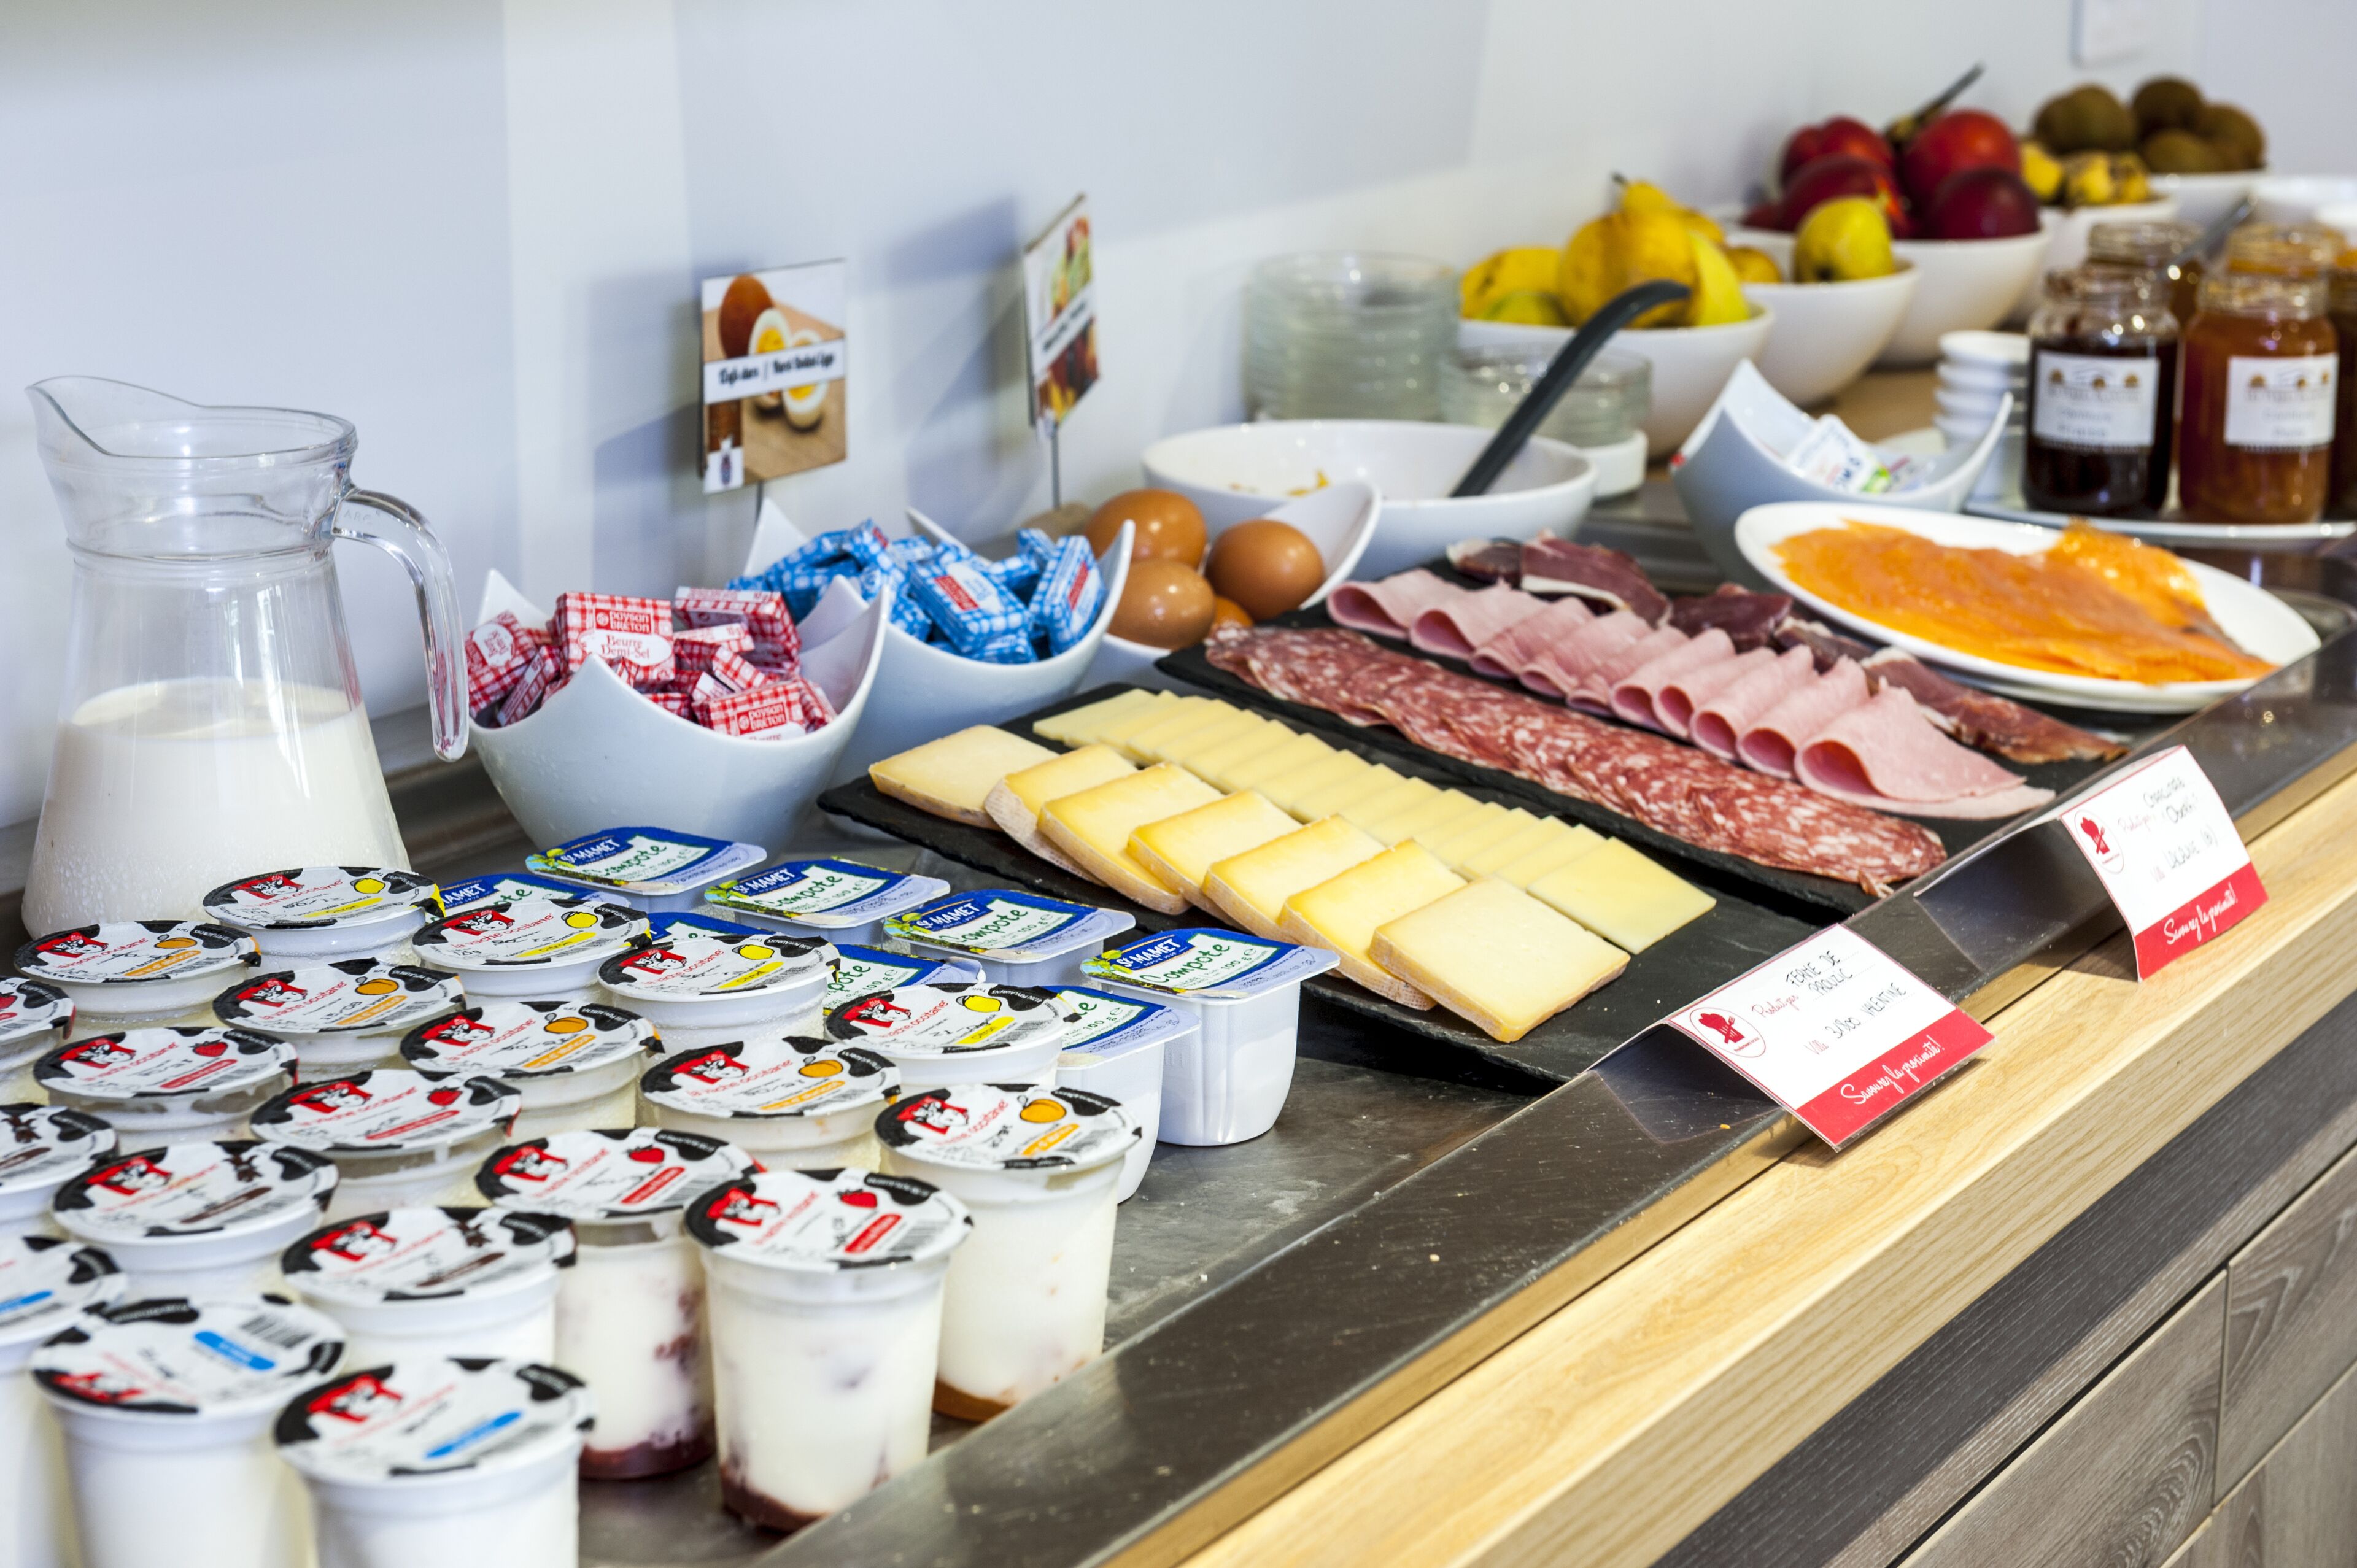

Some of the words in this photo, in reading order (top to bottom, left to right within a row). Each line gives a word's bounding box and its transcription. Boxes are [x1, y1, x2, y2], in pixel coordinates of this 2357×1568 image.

[610, 611, 649, 624] paysan
[601, 644, 650, 659] Demi-Sel
[606, 635, 643, 649] Beurre
[748, 703, 783, 718] paysan
[576, 837, 620, 860] MAMET
[582, 843, 667, 876] Compote
[733, 885, 749, 894] St
[745, 867, 795, 890] MAMET
[754, 875, 843, 907] Compote
[916, 919, 934, 929] St
[929, 902, 980, 925] MAMET
[937, 908, 1029, 943] Compote
[464, 932, 503, 946] vache
[503, 913, 554, 935] occitane
[2164, 917, 2202, 945] Savourez
[99, 937, 149, 957] occitane
[538, 941, 575, 952] Citron
[1117, 957, 1134, 968] St
[1128, 938, 1182, 964] MAMET
[683, 948, 726, 973] occitane
[1139, 944, 1231, 984] Compote
[1220, 960, 1242, 970] 100
[1786, 961, 1822, 987] FERME
[1819, 950, 1841, 967] DE
[827, 965, 872, 994] pote
[303, 981, 348, 1006] occitane
[991, 989, 1028, 1000] PUYLAURENS
[1859, 981, 1907, 1018] VALENTINE
[1751, 999, 1788, 1018] Produit
[491, 1018, 536, 1044] occitane
[1803, 1039, 1829, 1056] Ville
[1840, 1075, 1905, 1105] Savourez
[1881, 1064, 1905, 1080] la
[1902, 1033, 1946, 1084] proximité!
